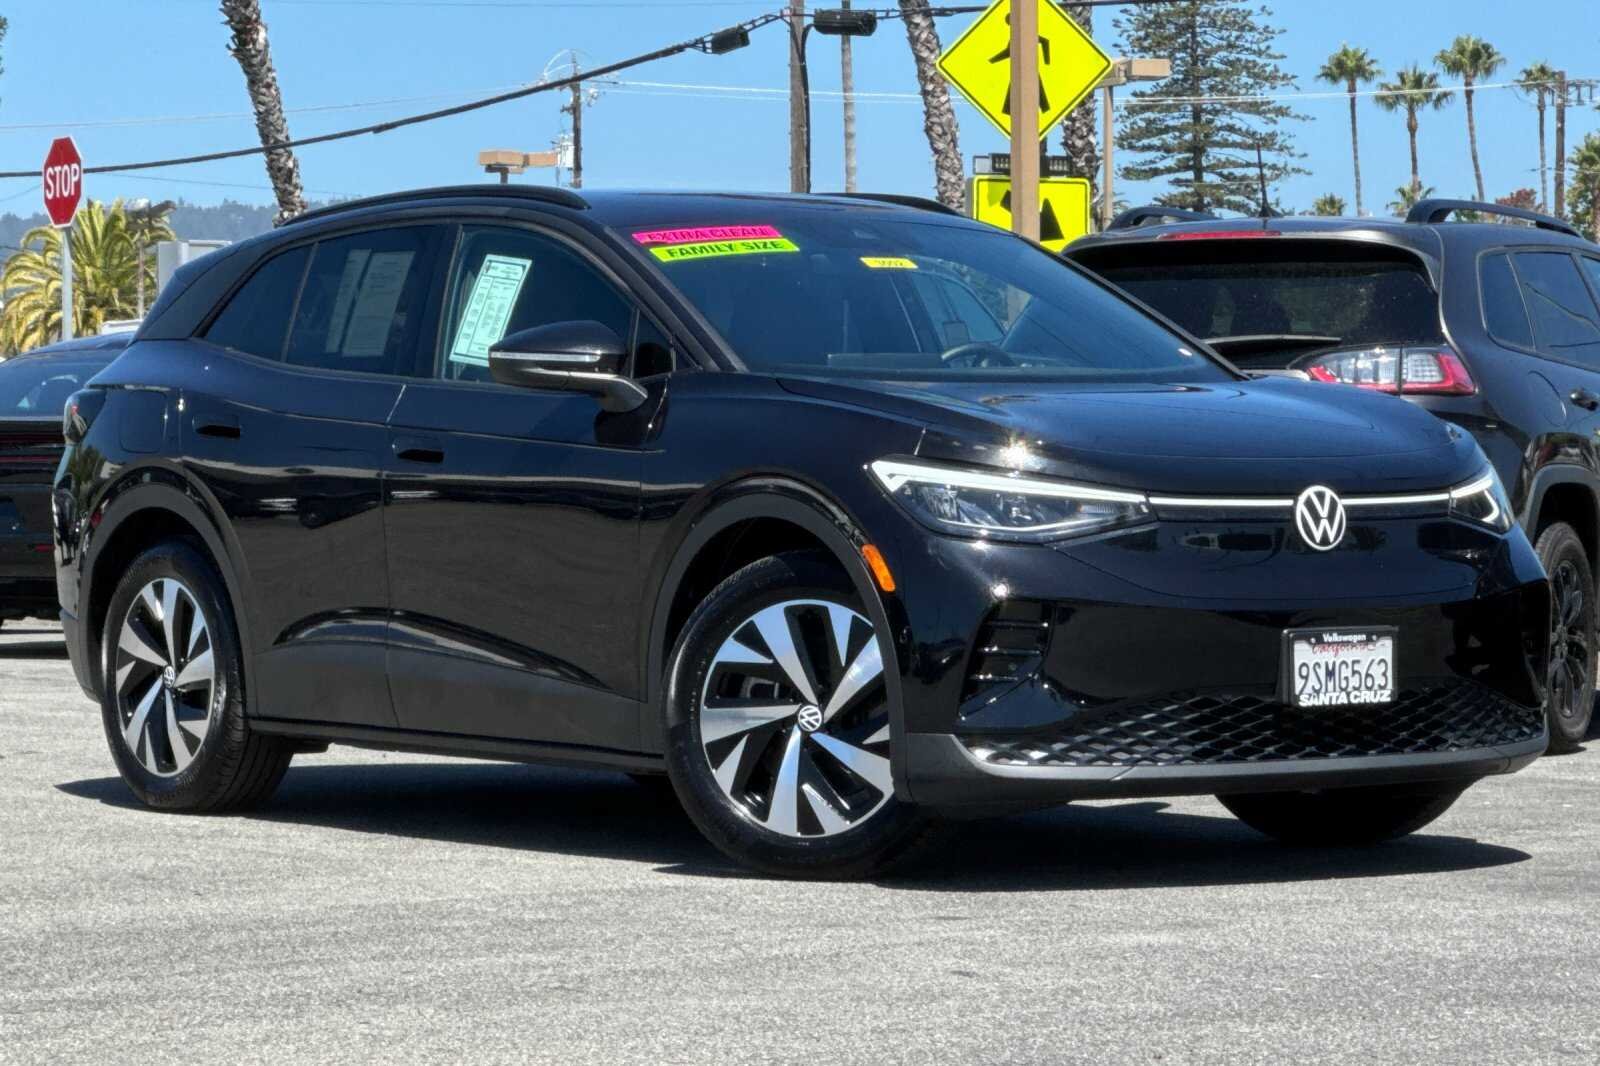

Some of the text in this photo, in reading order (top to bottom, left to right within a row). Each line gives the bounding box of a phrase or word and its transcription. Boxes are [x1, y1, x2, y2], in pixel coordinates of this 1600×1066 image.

[46, 163, 80, 200] STOP
[648, 227, 769, 241] EXTRA CLEAN
[666, 240, 785, 257] FAMILY SIZE
[1322, 633, 1367, 643] Volkswagen
[1298, 658, 1389, 695] 9SMG563
[1299, 689, 1392, 707] SANTA CRUZ
